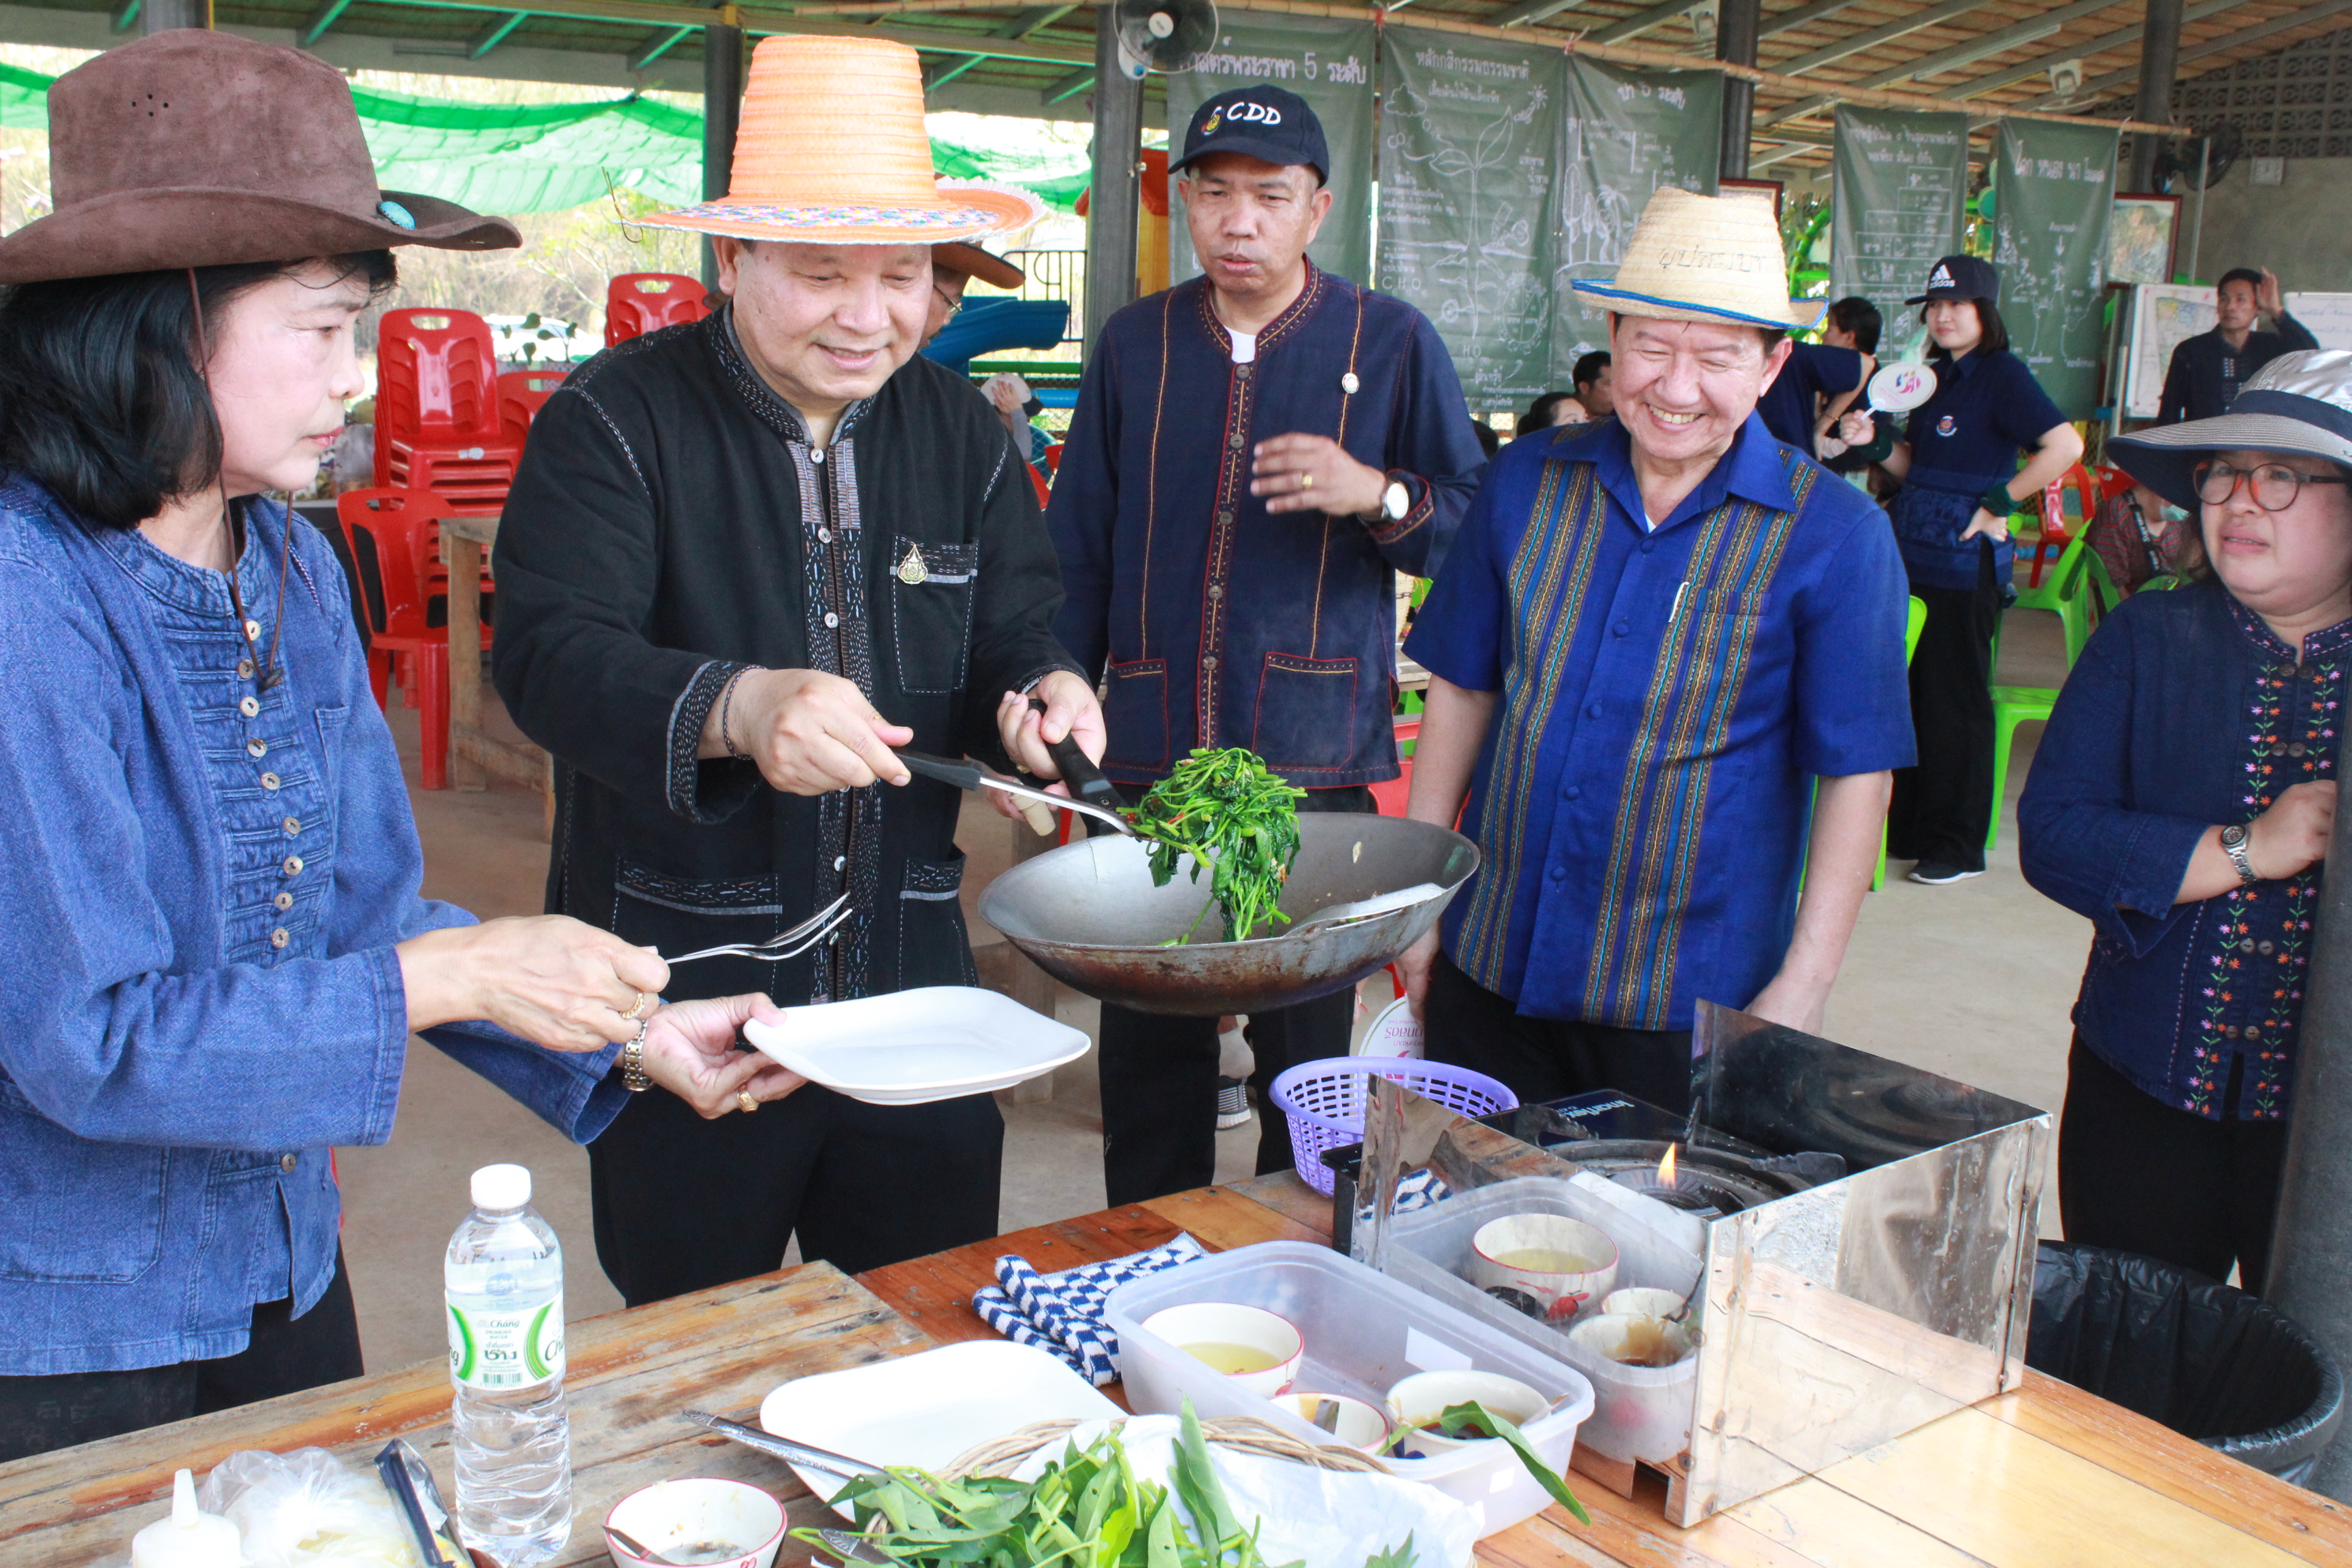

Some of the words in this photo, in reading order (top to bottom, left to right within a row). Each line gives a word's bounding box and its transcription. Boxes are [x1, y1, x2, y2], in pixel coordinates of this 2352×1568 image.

[1305, 52, 1318, 80] 5
[1327, 55, 1367, 84] ระดับ
[1226, 102, 1281, 125] CDD
[1929, 279, 1956, 289] adidas
[490, 1320, 520, 1328] Chang
[484, 1349, 517, 1360] ช้าง
